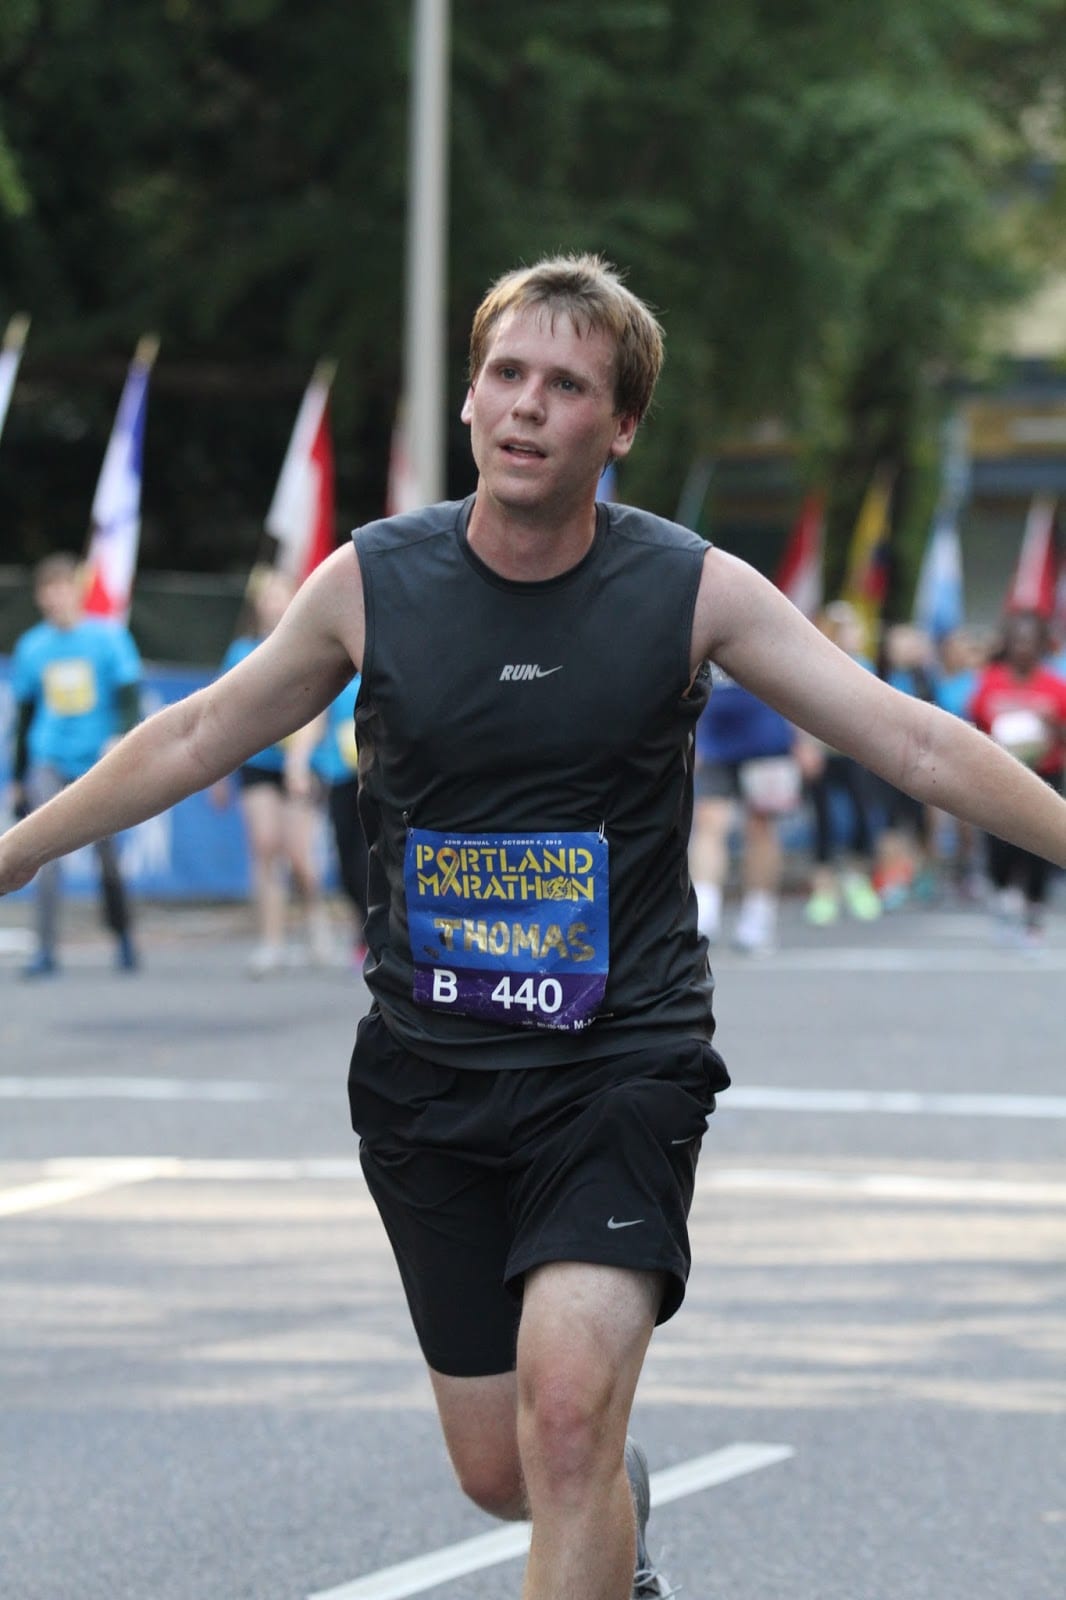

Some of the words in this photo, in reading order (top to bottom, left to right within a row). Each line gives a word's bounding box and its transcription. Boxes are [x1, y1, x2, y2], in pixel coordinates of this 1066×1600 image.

[499, 664, 539, 681] RUN
[416, 844, 594, 874] PORTLAND
[417, 871, 594, 903] MARATHON
[434, 917, 596, 962] THOMAS
[432, 968, 458, 1004] B
[491, 976, 563, 1014] 440
